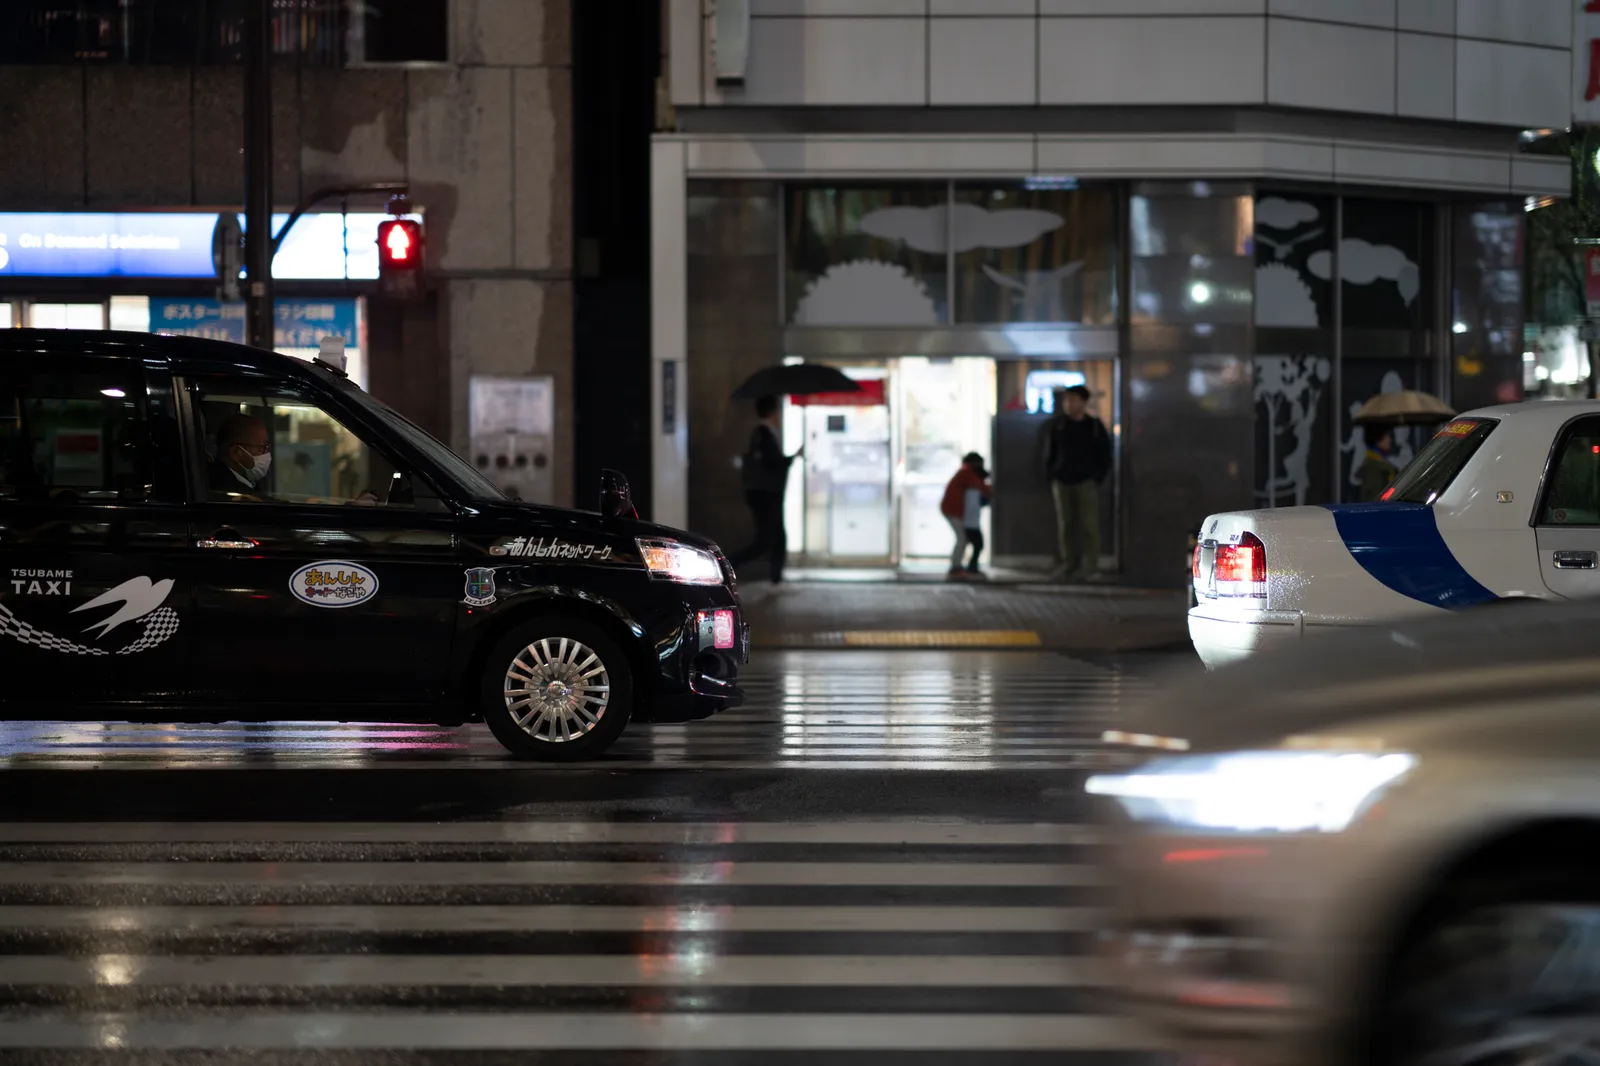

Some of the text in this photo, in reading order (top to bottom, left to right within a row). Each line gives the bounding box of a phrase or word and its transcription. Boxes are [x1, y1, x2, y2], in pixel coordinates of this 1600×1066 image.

[19, 232, 180, 249] On Demand Solutions
[509, 536, 612, 560] あんしんネットワーク
[11, 568, 73, 578] TSUBAME
[305, 568, 366, 585] あんしん
[11, 580, 71, 596] TAXI
